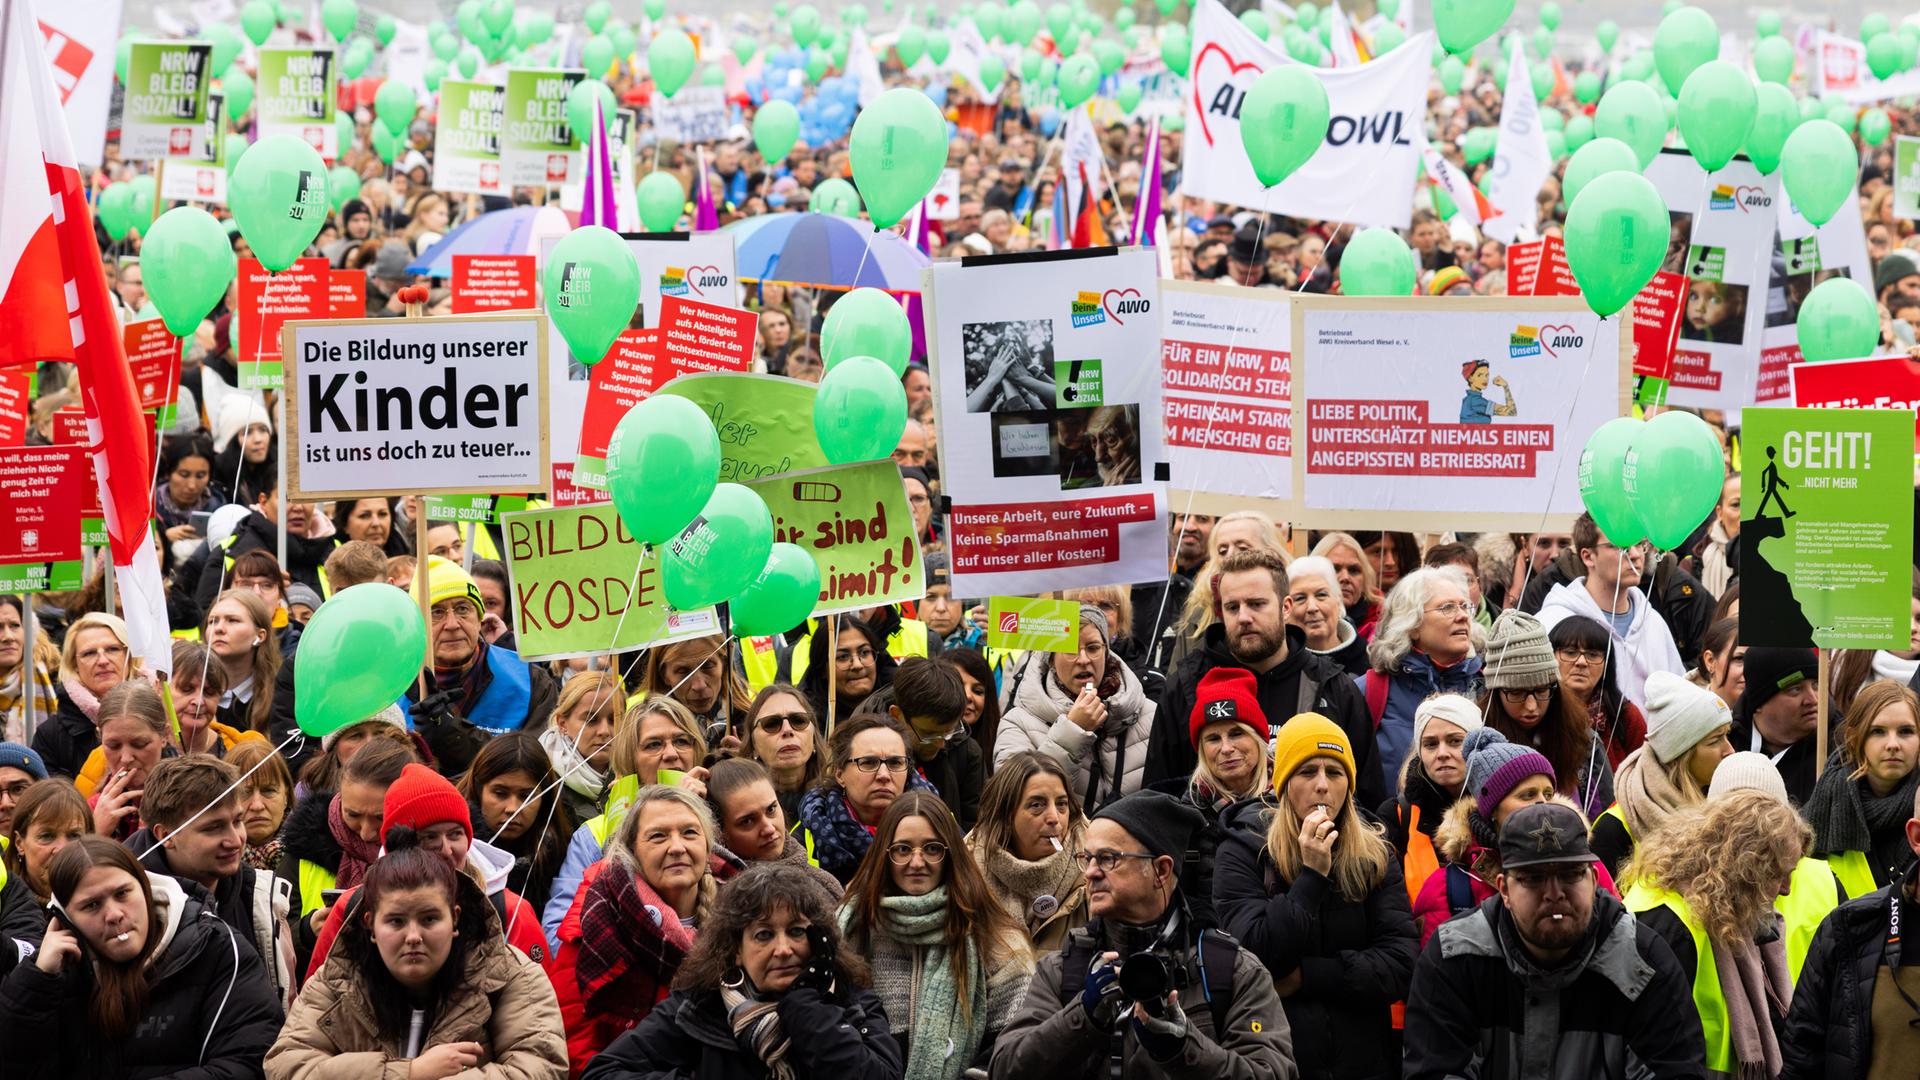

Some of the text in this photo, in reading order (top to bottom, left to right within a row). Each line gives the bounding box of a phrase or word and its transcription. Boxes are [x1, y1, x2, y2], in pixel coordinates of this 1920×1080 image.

[160, 52, 200, 72] NRW
[288, 56, 324, 76] NRW
[150, 74, 198, 94] BLEIB
[280, 76, 324, 97] BLEIB
[536, 79, 574, 100] NRW
[132, 95, 194, 117] SOZIAL!
[468, 90, 504, 110] NRW
[266, 98, 323, 118] SOZIAL!
[460, 110, 502, 130] BLEIB
[510, 124, 570, 143] SOZIAL!
[1326, 111, 1411, 146] OWL
[1744, 196, 1772, 208] AWO
[569, 267, 592, 279] NRW
[1654, 275, 1666, 285] der
[564, 280, 592, 293] BLEIB
[698, 276, 728, 287] AWO
[558, 294, 592, 307] SOZIAL!
[1654, 288, 1675, 299] spart,
[680, 305, 737, 324] Wer Menschen
[1072, 302, 1098, 312] Deine
[1116, 300, 1150, 314] AWO
[1640, 306, 1665, 318] Vielfalt
[1073, 313, 1104, 326] Unsere
[1172, 310, 1206, 320] Betriebsrat
[675, 318, 738, 338] aufs Abstellgleis
[1186, 320, 1225, 331] Kreisverband
[636, 336, 646, 344] an
[666, 330, 743, 352] schiebt, fördert den
[1511, 336, 1534, 344] Deine
[1552, 336, 1584, 348] AWO
[304, 338, 528, 364] Die Bildung unserer
[666, 342, 740, 364] Rechtsextremismus
[1162, 342, 1292, 374] FÜR EIN NRW, DA
[1511, 346, 1540, 356] Unsere
[614, 360, 653, 374] Wir zeige
[671, 357, 718, 372] und schadet
[1673, 354, 1705, 366] Arbeit
[611, 370, 652, 386] Sparpläne
[1078, 370, 1100, 378] NRW
[1674, 372, 1718, 386] Zukunft!
[1070, 381, 1100, 391] BLEIBT
[1161, 368, 1292, 396] SOLIDARISCH STEH
[308, 366, 529, 434] Kinder
[616, 398, 634, 408] rote
[1071, 394, 1101, 403] SOZIAL
[1163, 400, 1244, 425] EMEINSAM
[1312, 404, 1422, 424] LIEBE POLITIK,
[1181, 426, 1261, 449] MENSCHEN
[1312, 424, 1550, 446] UNTERSCHÄTZT NIEMALS EINEN
[23, 452, 42, 463] dass
[44, 451, 70, 462] meine
[306, 440, 531, 463] ist uns doch zu teuer...
[1782, 430, 1872, 470] GEHT!
[1312, 450, 1527, 470] ANGEPISSTEN BETRIEBSRAT!
[0, 464, 65, 475] rzieherin Nicole
[1, 476, 58, 488] genug Zeit für
[582, 472, 606, 486] BLEIB
[1796, 477, 1858, 489] ...NICHT MEHR
[10, 488, 50, 498] mich hat!
[556, 490, 590, 502] kürzt,
[472, 498, 492, 509] NRW
[432, 506, 456, 518] BLEIB
[954, 502, 1136, 525] Unsere Arbeit, eure Zukunft
[773, 500, 888, 548] ir sind
[510, 512, 636, 561] BILDU
[694, 522, 719, 545] NRW
[956, 527, 1109, 546] Keine Sparmaßnahmen
[682, 530, 710, 556] BLEIB
[670, 540, 705, 567] SOZIAL!
[956, 546, 1106, 567] auf unser aller Kosten!
[26, 566, 47, 578] NRW
[15, 578, 48, 590] SOZIAL!
[1039, 902, 1055, 912] AWO
[1890, 896, 1900, 935] SONY
